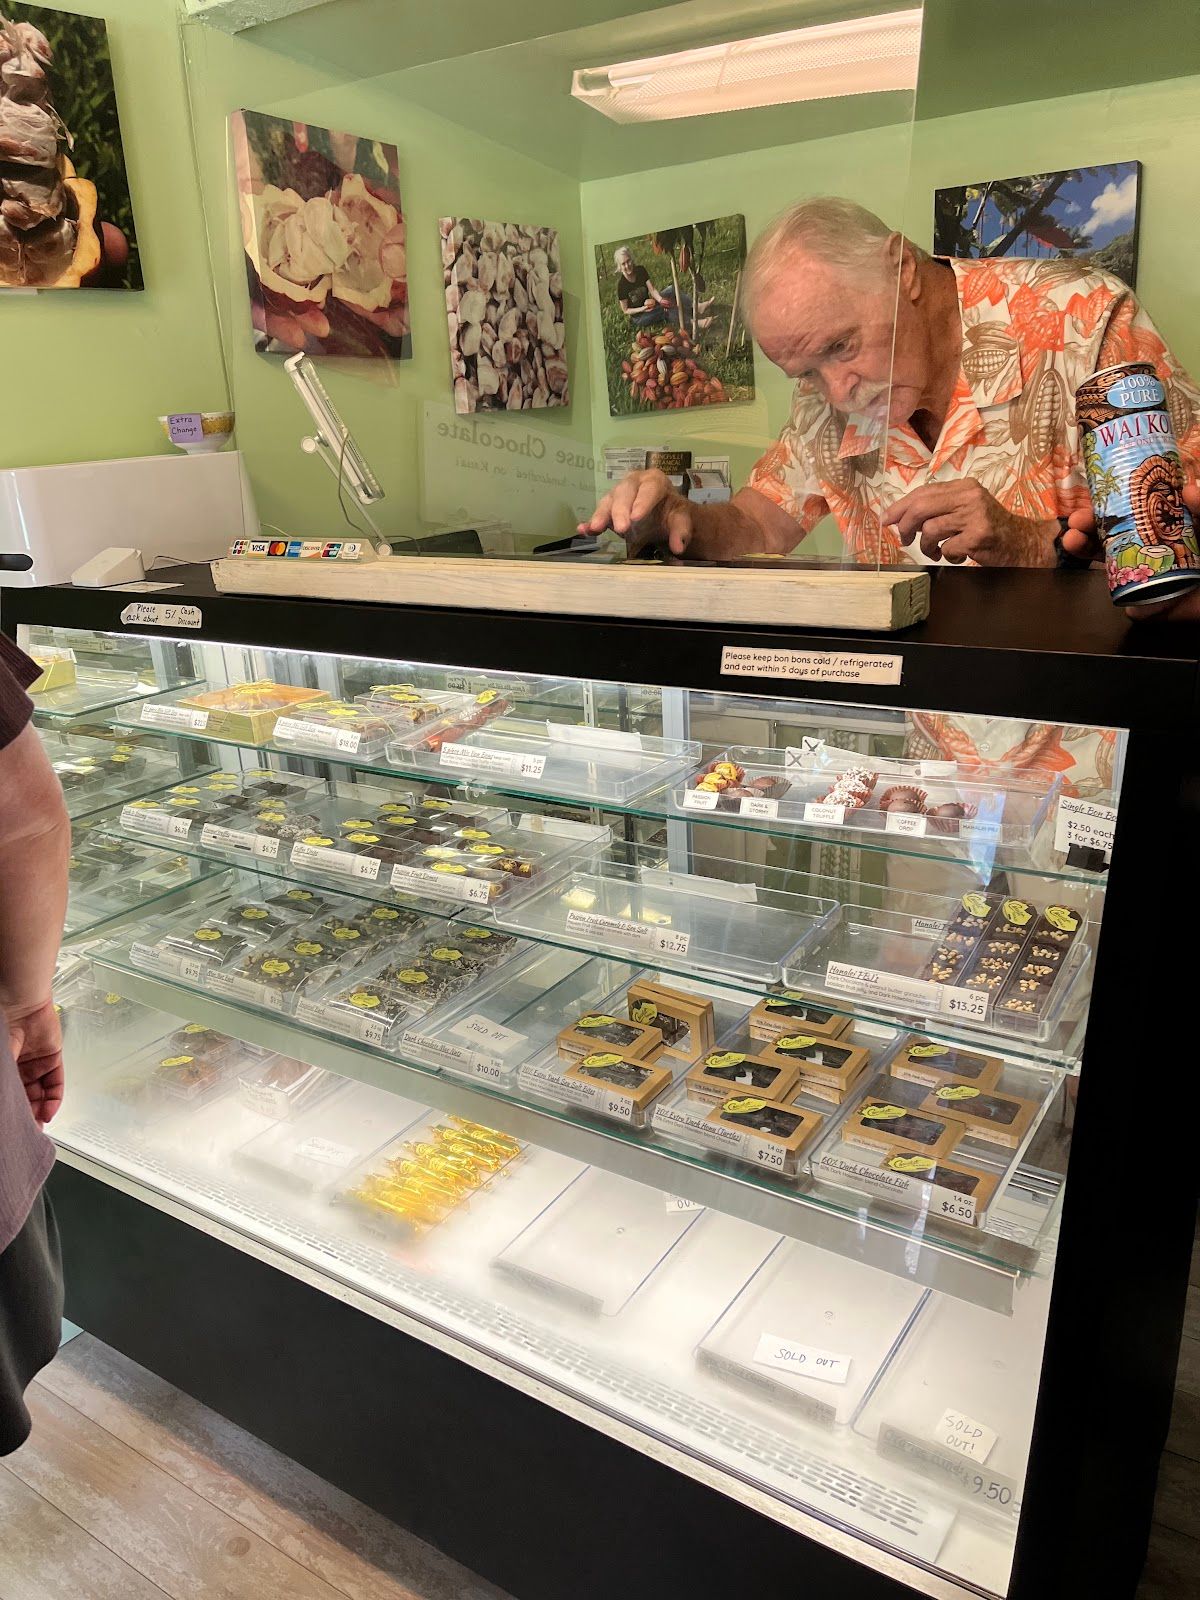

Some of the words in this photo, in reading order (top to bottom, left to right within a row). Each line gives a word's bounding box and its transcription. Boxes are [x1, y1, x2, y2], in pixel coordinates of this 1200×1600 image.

[1120, 375, 1155, 390] 100%
[1120, 390, 1159, 407] PURE
[170, 417, 192, 425] Extra
[171, 426, 198, 436] Change
[1099, 416, 1143, 447] WAI
[1146, 414, 1172, 434] KO
[252, 544, 265, 552] VISA
[136, 604, 156, 613] Please
[165, 609, 177, 619] 5%
[180, 607, 195, 615] Cash
[142, 615, 159, 624] about
[177, 617, 200, 626] Discount
[725, 652, 751, 660] Please
[753, 653, 772, 662] keep
[791, 656, 811, 664] bons
[813, 657, 831, 665] cold
[840, 659, 894, 669] refrigerated
[756, 664, 780, 673] within
[781, 665, 787, 673] 5
[788, 667, 808, 676] days
[821, 668, 861, 678] purchase
[521, 764, 542, 774] $11.25
[1060, 799, 1085, 814] Single
[1087, 806, 1103, 817] Bon
[1105, 811, 1118, 821] Bo
[1067, 820, 1091, 833] $2.50
[1093, 830, 1115, 840] each
[1067, 831, 1072, 839] 3
[1074, 832, 1088, 843] for
[1090, 837, 1113, 850] $6.75
[468, 889, 487, 900] $6.75
[586, 916, 598, 925] Fruit
[626, 924, 637, 933] Sea
[637, 926, 649, 935] Salt
[660, 939, 686, 953] $12.75
[828, 965, 857, 979] Hanalei
[888, 986, 903, 994] butter
[949, 999, 984, 1015] $13.25
[365, 1029, 381, 1041] $9.75
[404, 1033, 418, 1043] Dark
[466, 1022, 489, 1035] SOLD
[491, 1032, 508, 1041] OUT
[475, 1058, 500, 1073] $10.00
[533, 1070, 546, 1079] Extra
[546, 1074, 561, 1083] Dark
[561, 1078, 570, 1087] Sea
[570, 1081, 583, 1091] Salt
[608, 1102, 631, 1116] $9.50
[656, 1107, 669, 1115] 70%
[669, 1109, 685, 1122] Extra
[685, 1115, 701, 1127] Dark
[717, 1127, 741, 1142] (Turtles)
[757, 1150, 783, 1166] $7.50
[821, 1155, 839, 1168] 60%
[838, 1162, 858, 1175] Dark
[858, 1167, 893, 1185] Chocolate
[893, 1178, 910, 1190] Fish
[829, 1167, 842, 1175] Dark
[864, 1178, 878, 1186] Blend
[941, 1201, 972, 1219] $6.50
[774, 1348, 806, 1364] SOLD
[816, 1357, 840, 1369] OUT
[945, 1415, 983, 1438] SOLD
[946, 1434, 975, 1454] OUT!
